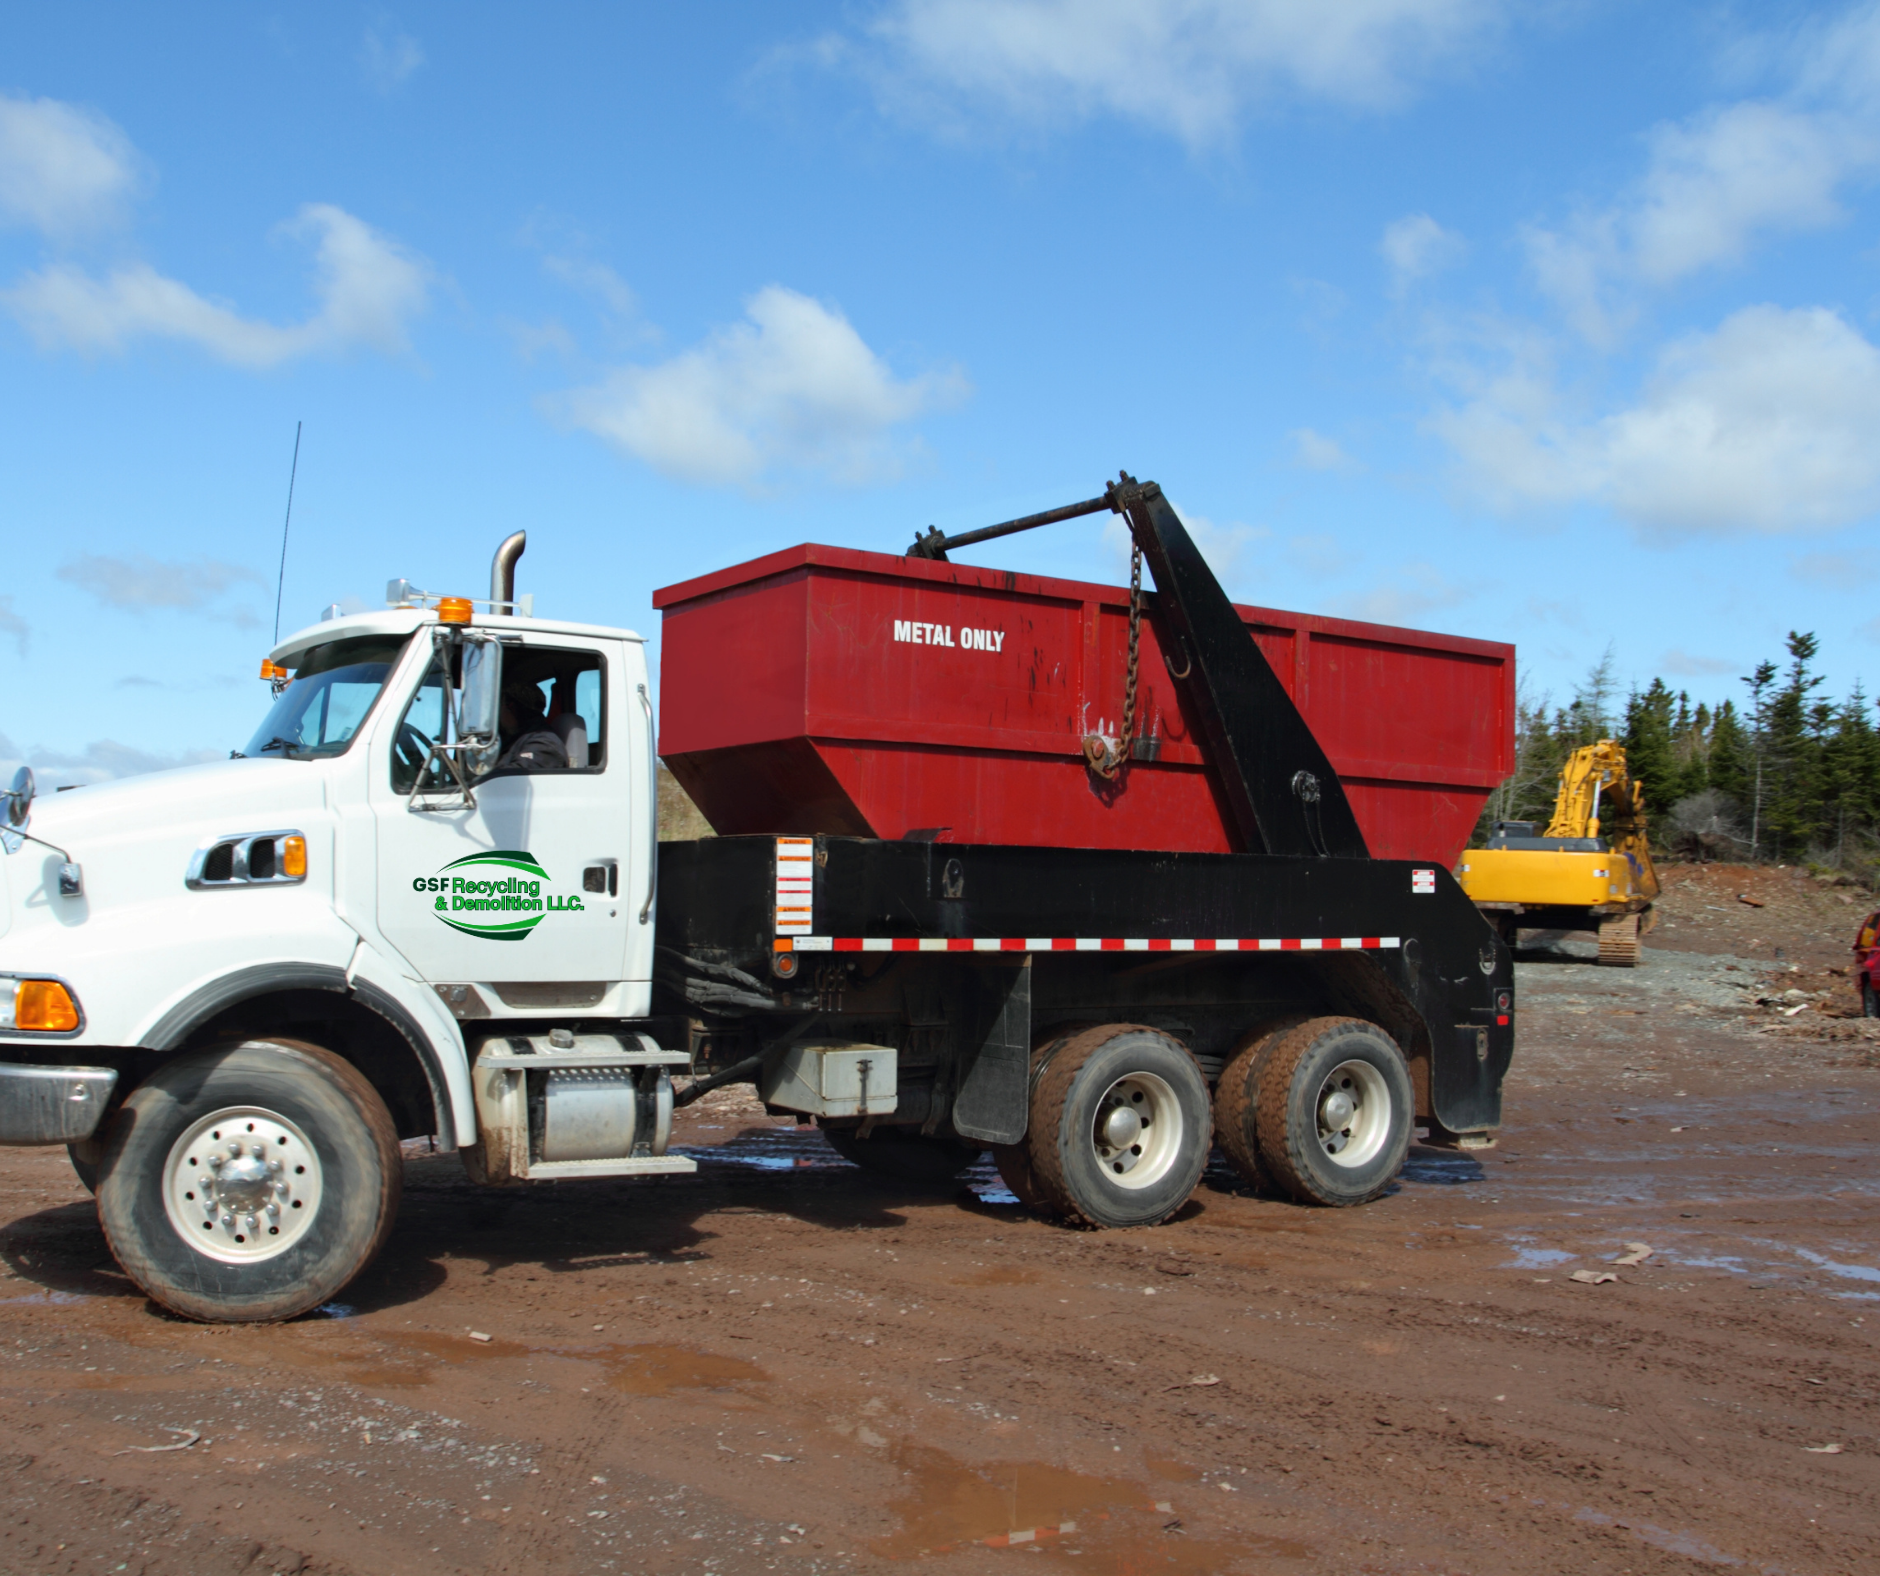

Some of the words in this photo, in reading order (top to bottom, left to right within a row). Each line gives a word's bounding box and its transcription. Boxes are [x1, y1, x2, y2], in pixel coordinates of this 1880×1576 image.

[894, 619, 955, 647] METAL
[960, 627, 1005, 652] ONLY
[412, 877, 450, 892] GSF
[452, 877, 540, 897] Recycling
[434, 896, 449, 911] &
[452, 896, 543, 911] Demolition
[547, 896, 585, 911] LLC.
